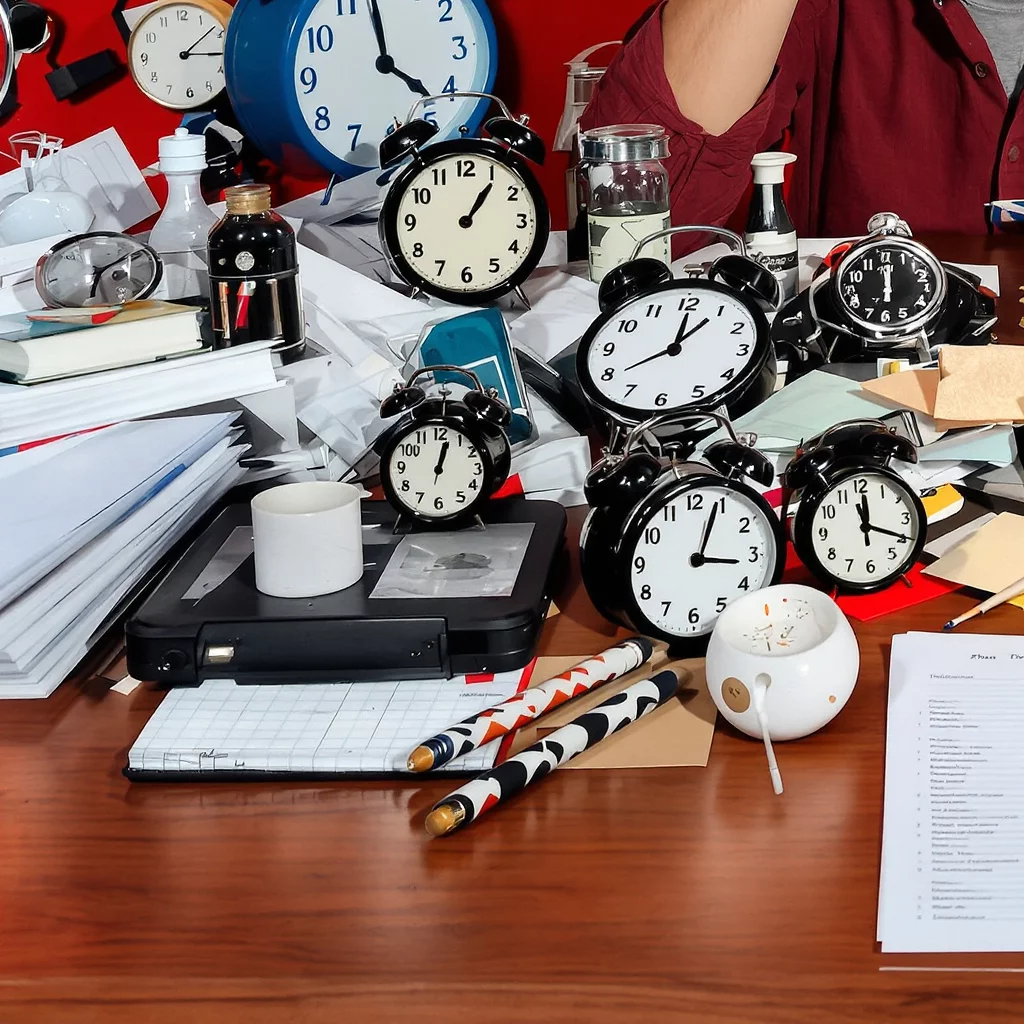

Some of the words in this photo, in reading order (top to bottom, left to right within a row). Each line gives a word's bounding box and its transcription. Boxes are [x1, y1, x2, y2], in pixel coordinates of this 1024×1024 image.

[307, 25, 333, 53] 10
[452, 36, 467, 60] 3
[300, 67, 317, 94] 9
[315, 106, 330, 131] 8
[457, 160, 475, 177] 12
[490, 165, 493, 180] 1
[432, 169, 445, 185] 11
[412, 188, 431, 204] 10
[508, 186, 518, 201] 2
[405, 214, 416, 231] 9
[516, 214, 527, 229] 3
[413, 243, 423, 257] 8
[508, 240, 519, 254] 4
[435, 260, 445, 276] 7
[489, 258, 499, 273] 5
[461, 267, 472, 283] 6
[646, 305, 662, 317] 11
[678, 298, 699, 311] 12
[618, 320, 637, 333] 10
[603, 343, 615, 356] 9
[736, 344, 749, 356] 3
[601, 368, 614, 381] 8
[434, 497, 443, 510] 6
[687, 494, 703, 510] 12
[720, 497, 725, 513] 1
[663, 506, 675, 521] 11
[822, 505, 835, 519] 10
[739, 517, 750, 533] 2
[645, 527, 660, 544] 10
[749, 547, 758, 562] 3
[634, 557, 645, 574] 9
[738, 576, 749, 591] 4
[641, 585, 651, 600] 8
[661, 602, 671, 616] 7
[716, 597, 727, 613] 5
[688, 608, 699, 623] 6
